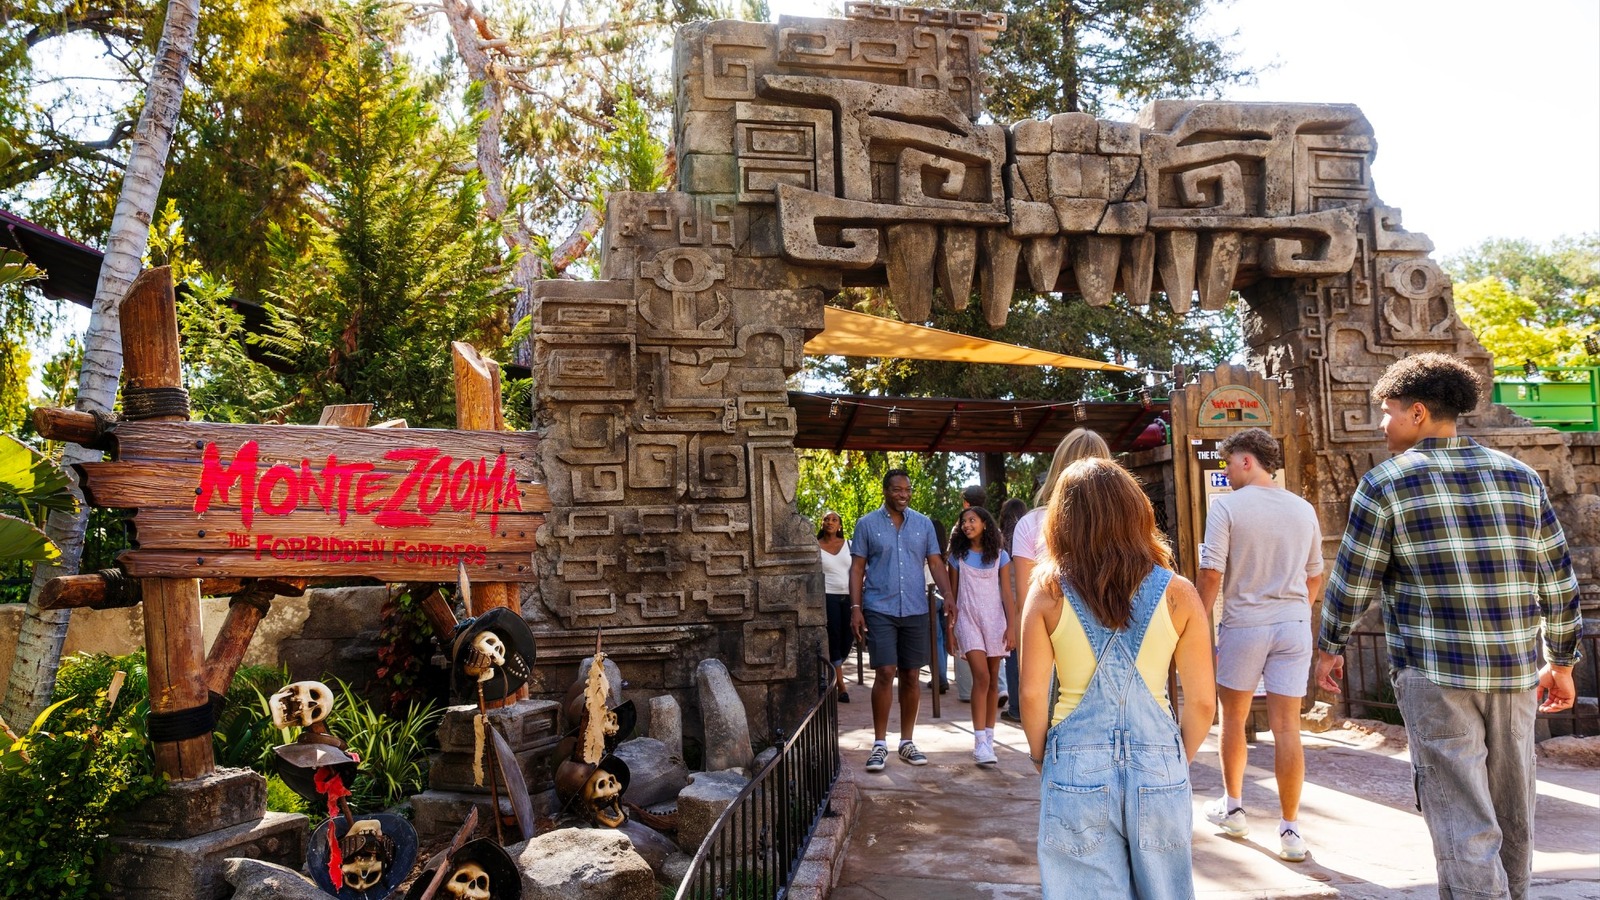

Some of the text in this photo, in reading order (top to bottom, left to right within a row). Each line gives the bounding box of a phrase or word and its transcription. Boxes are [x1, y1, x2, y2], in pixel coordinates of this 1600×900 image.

[1210, 398, 1259, 409] WAIT TIME
[1197, 451, 1210, 460] THE
[226, 532, 487, 567] THE FORBIDDEN FORTRESS
